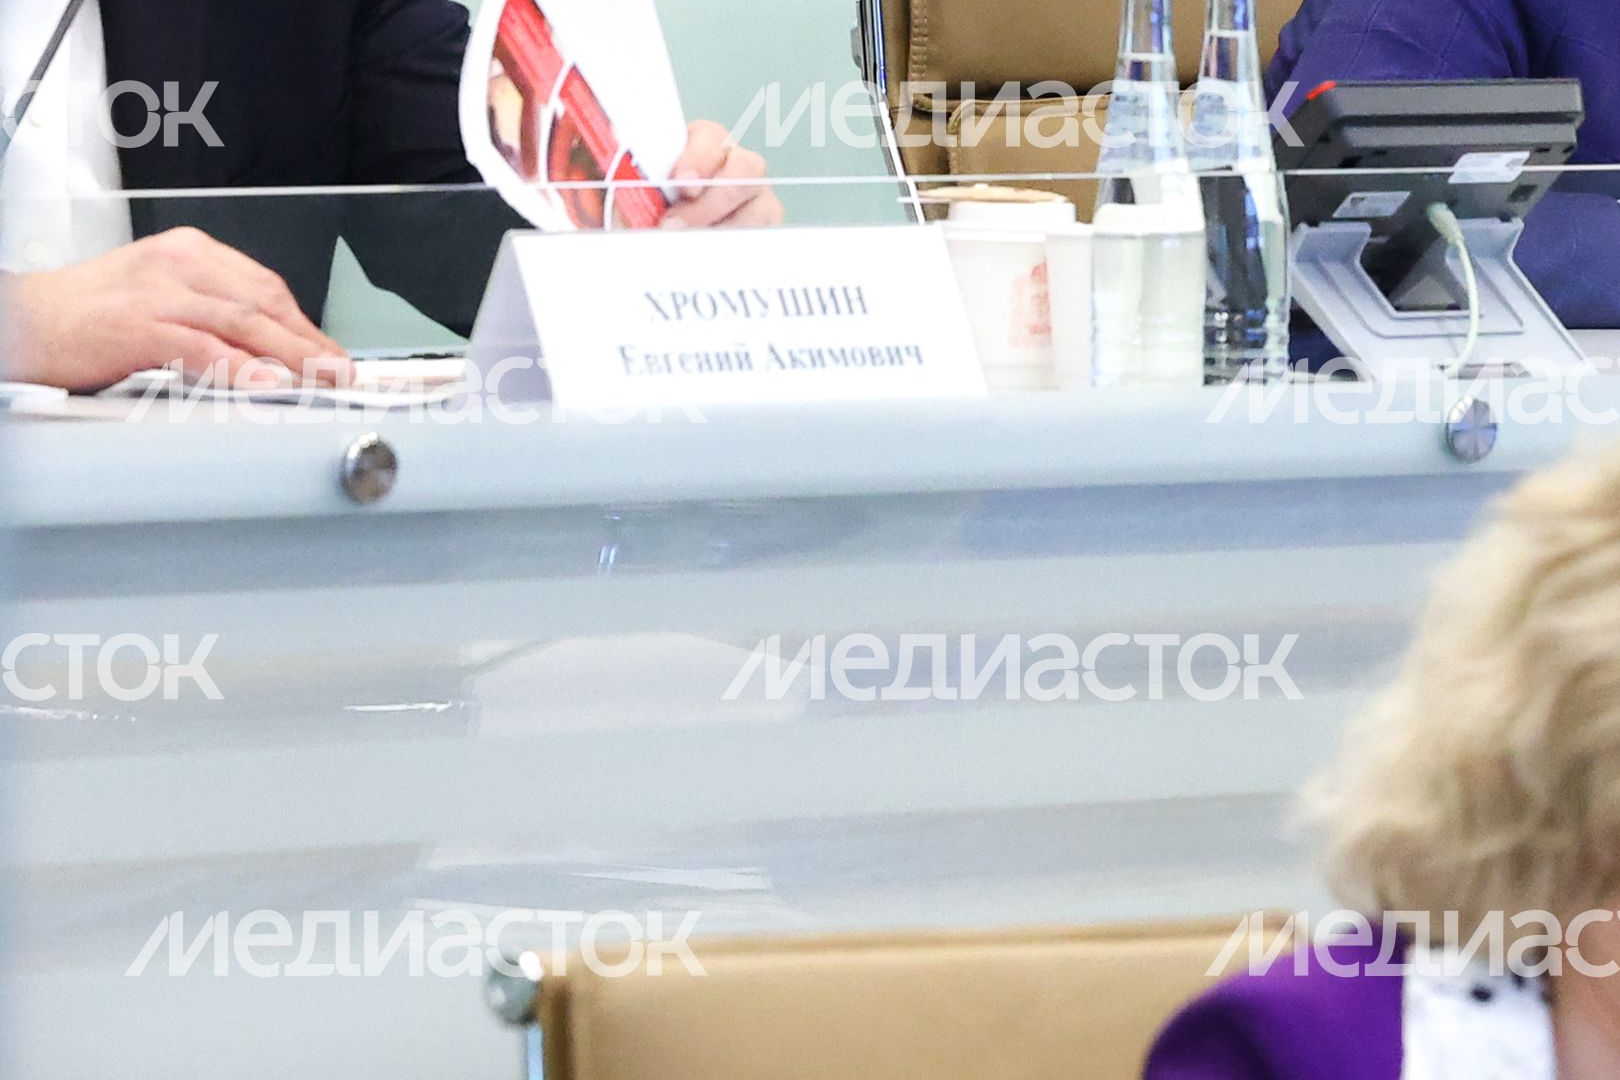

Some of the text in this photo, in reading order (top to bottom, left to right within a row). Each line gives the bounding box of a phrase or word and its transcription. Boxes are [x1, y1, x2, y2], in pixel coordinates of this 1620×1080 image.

[644, 285, 870, 322] ХРОМУШИН
[618, 341, 925, 376] Евгений Акимович
